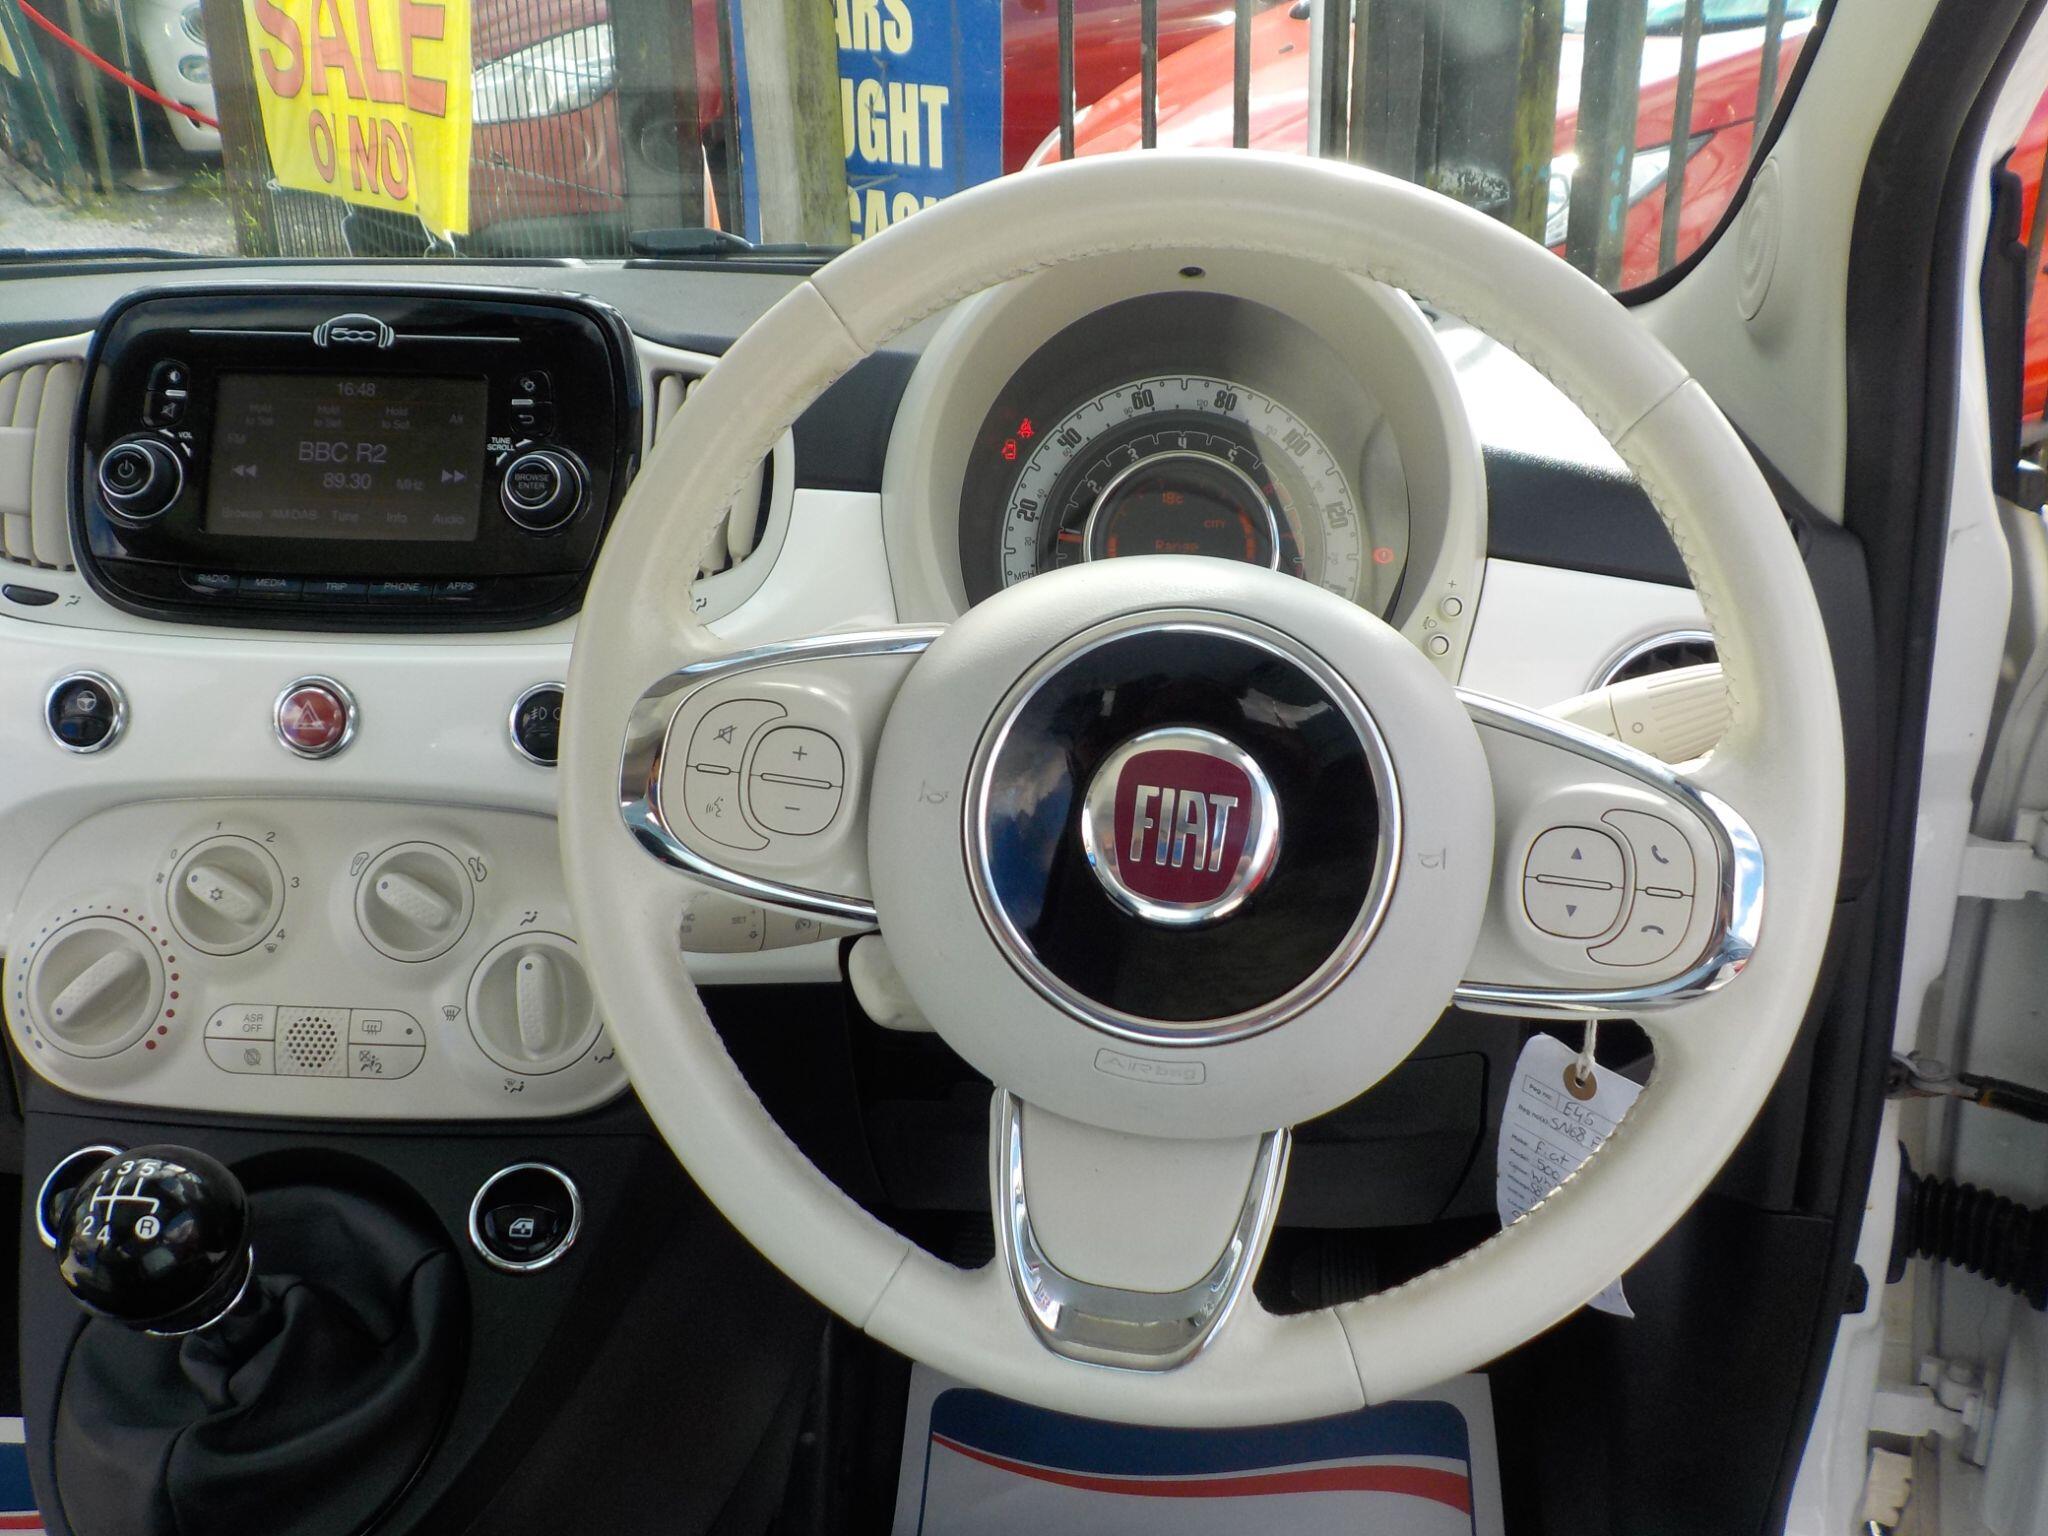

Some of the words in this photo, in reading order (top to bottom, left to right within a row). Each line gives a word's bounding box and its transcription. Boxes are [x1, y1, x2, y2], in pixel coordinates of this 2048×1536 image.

[253, 0, 448, 118] SALE
[1131, 389, 1155, 411] 60
[1214, 389, 1238, 411] 80
[491, 436, 512, 445] TUNE
[1057, 427, 1083, 449] 40
[1178, 436, 1187, 450] 4
[1282, 428, 1312, 457] 100
[298, 441, 348, 463] BBC
[356, 443, 387, 464] R2
[1127, 447, 1139, 462] 3
[323, 472, 372, 490] 89.30
[514, 473, 549, 482] BROWSE
[518, 482, 546, 490] ENTER
[1017, 498, 1039, 522] 20
[1325, 501, 1349, 529] 120
[432, 513, 465, 525] Audio
[198, 573, 231, 584] RADIO
[255, 577, 286, 588] MEDIA
[325, 582, 349, 592] TRIP
[383, 582, 420, 592] PHONE
[446, 581, 476, 592] APPS
[216, 821, 222, 831] 1
[1129, 784, 1239, 872] FIAT
[265, 831, 276, 842] 2
[290, 876, 300, 888] 3
[277, 928, 286, 940] 4
[243, 1013, 263, 1023] ASR
[242, 1023, 263, 1033] OFF
[117, 1160, 135, 1175] 3
[140, 1162, 156, 1177] 5
[100, 1168, 111, 1183] 1
[81, 1215, 95, 1236] 2
[139, 1218, 155, 1236] R
[96, 1224, 111, 1246] 4
